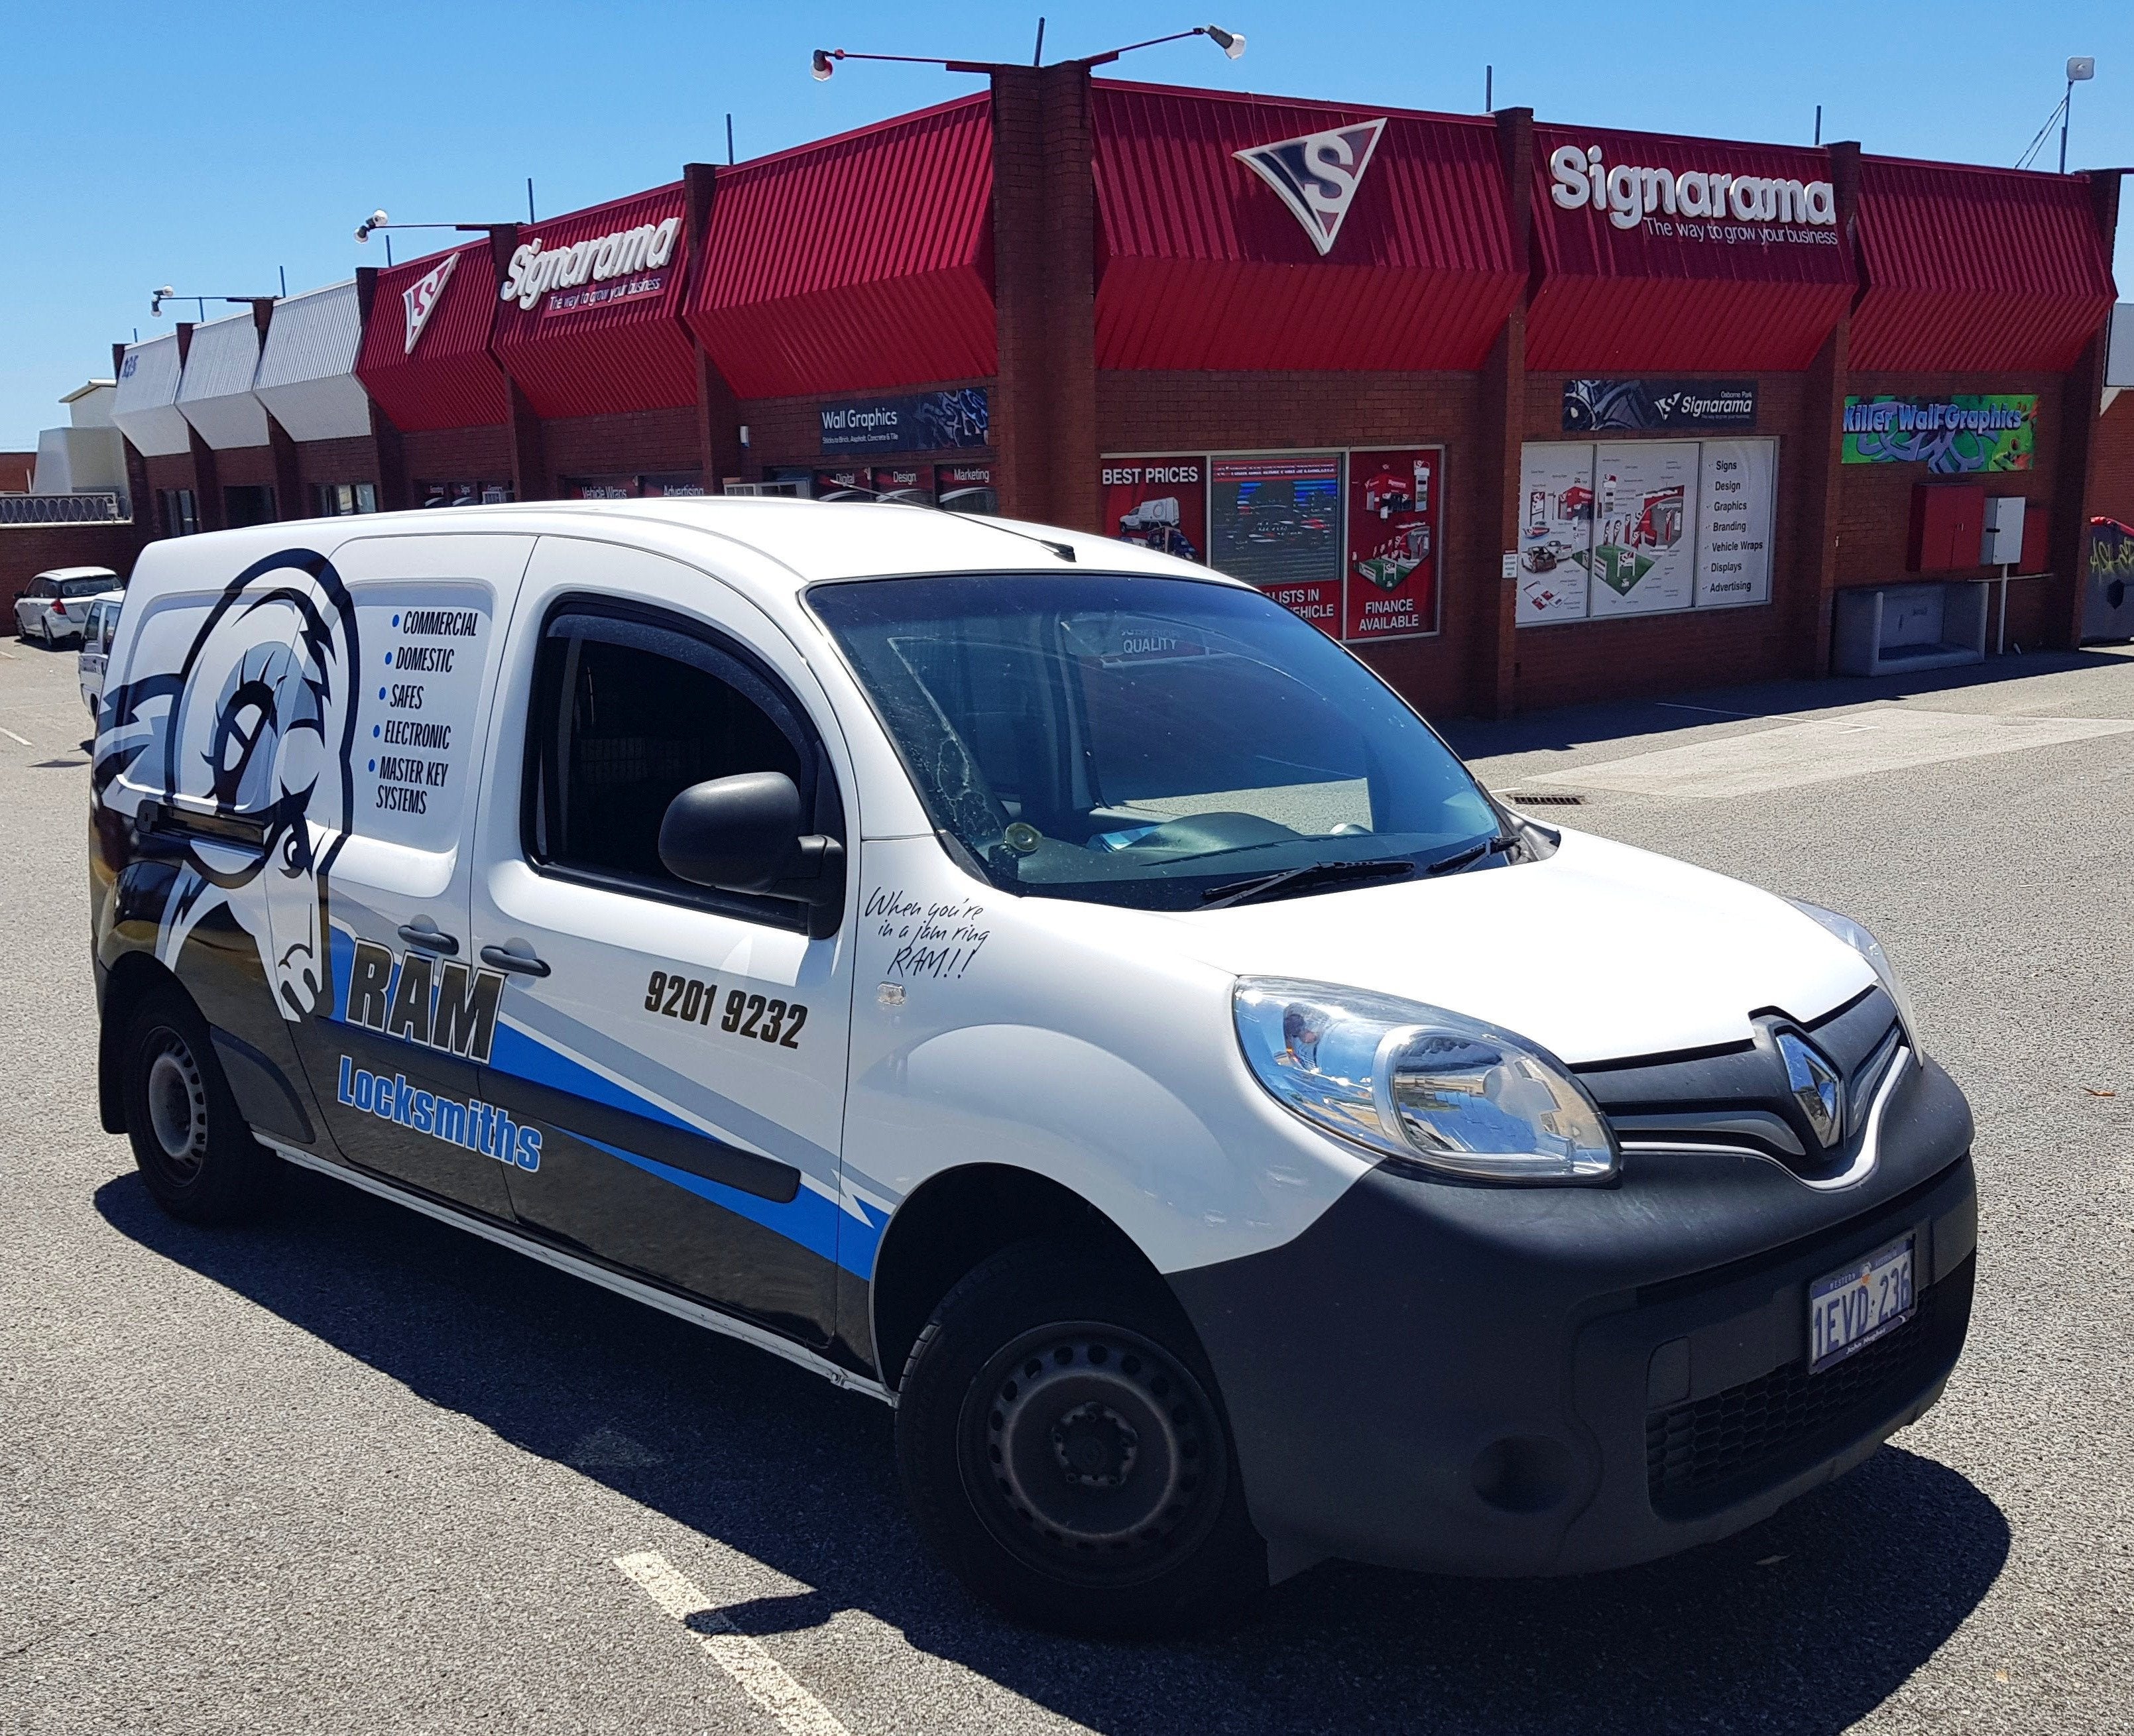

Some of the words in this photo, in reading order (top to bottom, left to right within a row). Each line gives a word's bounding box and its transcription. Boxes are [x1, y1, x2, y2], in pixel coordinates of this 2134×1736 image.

[1550, 145, 1836, 229] Signarama
[1643, 217, 1673, 236] The
[1675, 223, 1704, 242] way
[1706, 223, 1723, 239] to
[1724, 226, 1756, 244] grow
[1757, 227, 1785, 245] your
[1785, 225, 1838, 245] business
[501, 217, 682, 310] Signarama
[550, 296, 563, 311] The
[563, 295, 580, 310] way
[581, 291, 590, 304] to
[589, 288, 610, 307] grow
[608, 284, 627, 304] your
[627, 277, 662, 295] business
[1681, 396, 1753, 417] Signarama
[1843, 404, 1893, 432] Killer
[1897, 403, 1940, 431] Wall
[1944, 402, 2021, 435] Graphics
[822, 410, 846, 430] Wall
[848, 407, 898, 432] Graphics
[894, 471, 917, 485] Design
[954, 469, 989, 483] Marketing
[1102, 469, 1142, 485] BEST
[1146, 466, 1199, 483] PRICES
[1716, 460, 1737, 473] Signs
[663, 485, 704, 496] Advertising
[1715, 481, 1741, 492] Design
[1714, 500, 1747, 513] Graphics
[1713, 521, 1746, 533] Branding
[1712, 541, 1738, 552] Vehicle
[1740, 540, 1763, 551] Wraps
[1711, 562, 1742, 573] Displays
[1308, 589, 1320, 601] IN
[1710, 581, 1751, 593] Advertising
[1290, 603, 1334, 619] EHICLE
[1366, 598, 1413, 614] FINANCE
[403, 611, 478, 636] COMMERCIAL
[1359, 614, 1419, 632] AVAILABLE
[1123, 638, 1177, 654] QUALITY
[396, 646, 455, 673] DOMESTIC
[390, 684, 424, 709] SAFES
[384, 720, 451, 750] ELECTRONIC
[379, 756, 424, 784] MASTER
[426, 761, 449, 787] KEY
[376, 784, 427, 815] SYSTEMS
[865, 887, 921, 917] When
[925, 897, 984, 929] you're
[878, 919, 893, 937] in
[899, 925, 909, 938] a
[908, 920, 947, 949] jam
[952, 924, 990, 953] ring
[888, 947, 977, 978] RAM!!
[345, 937, 508, 1065] RAM
[644, 970, 718, 1026] 9201
[721, 989, 808, 1050] 9232
[337, 1055, 542, 1173] Locksmiths
